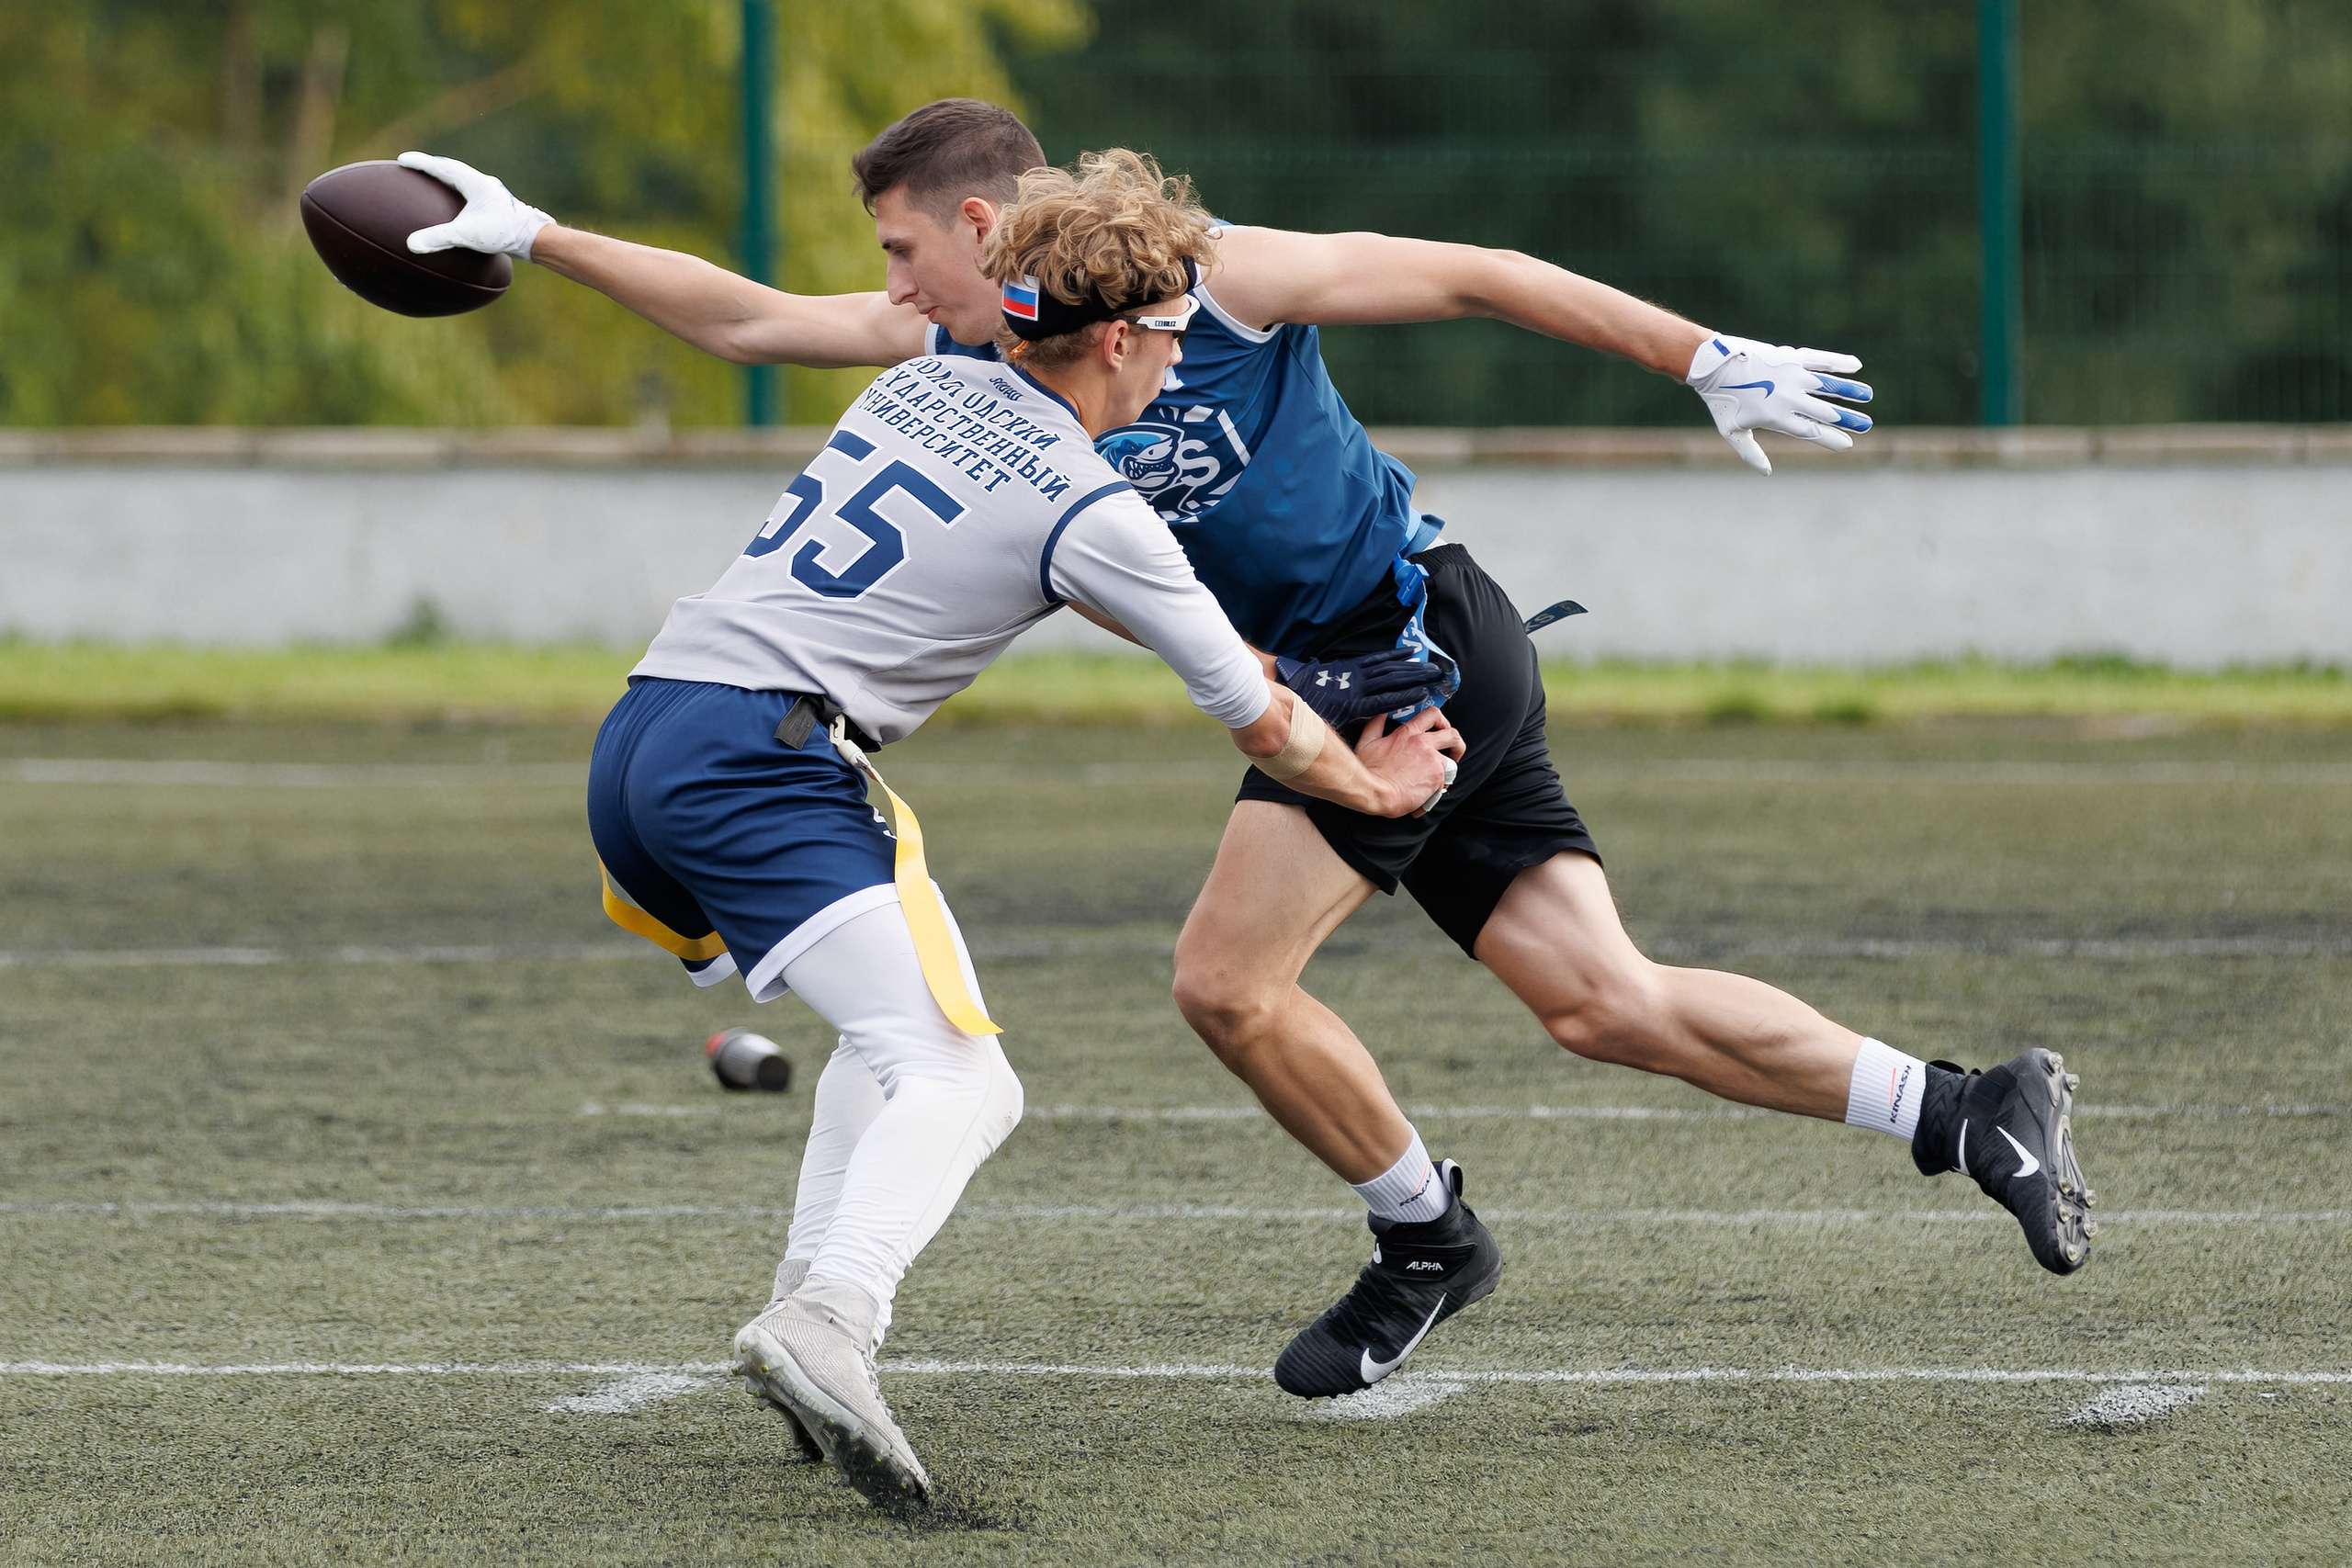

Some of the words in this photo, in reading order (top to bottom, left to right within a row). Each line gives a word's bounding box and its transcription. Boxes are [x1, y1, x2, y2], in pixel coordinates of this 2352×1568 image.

[858, 387, 1012, 492] УНИВЕРСИТЕТ
[741, 428, 968, 600] 55
[1889, 1065, 1912, 1123] KINASH
[1406, 1261, 1444, 1272] ALPHA
